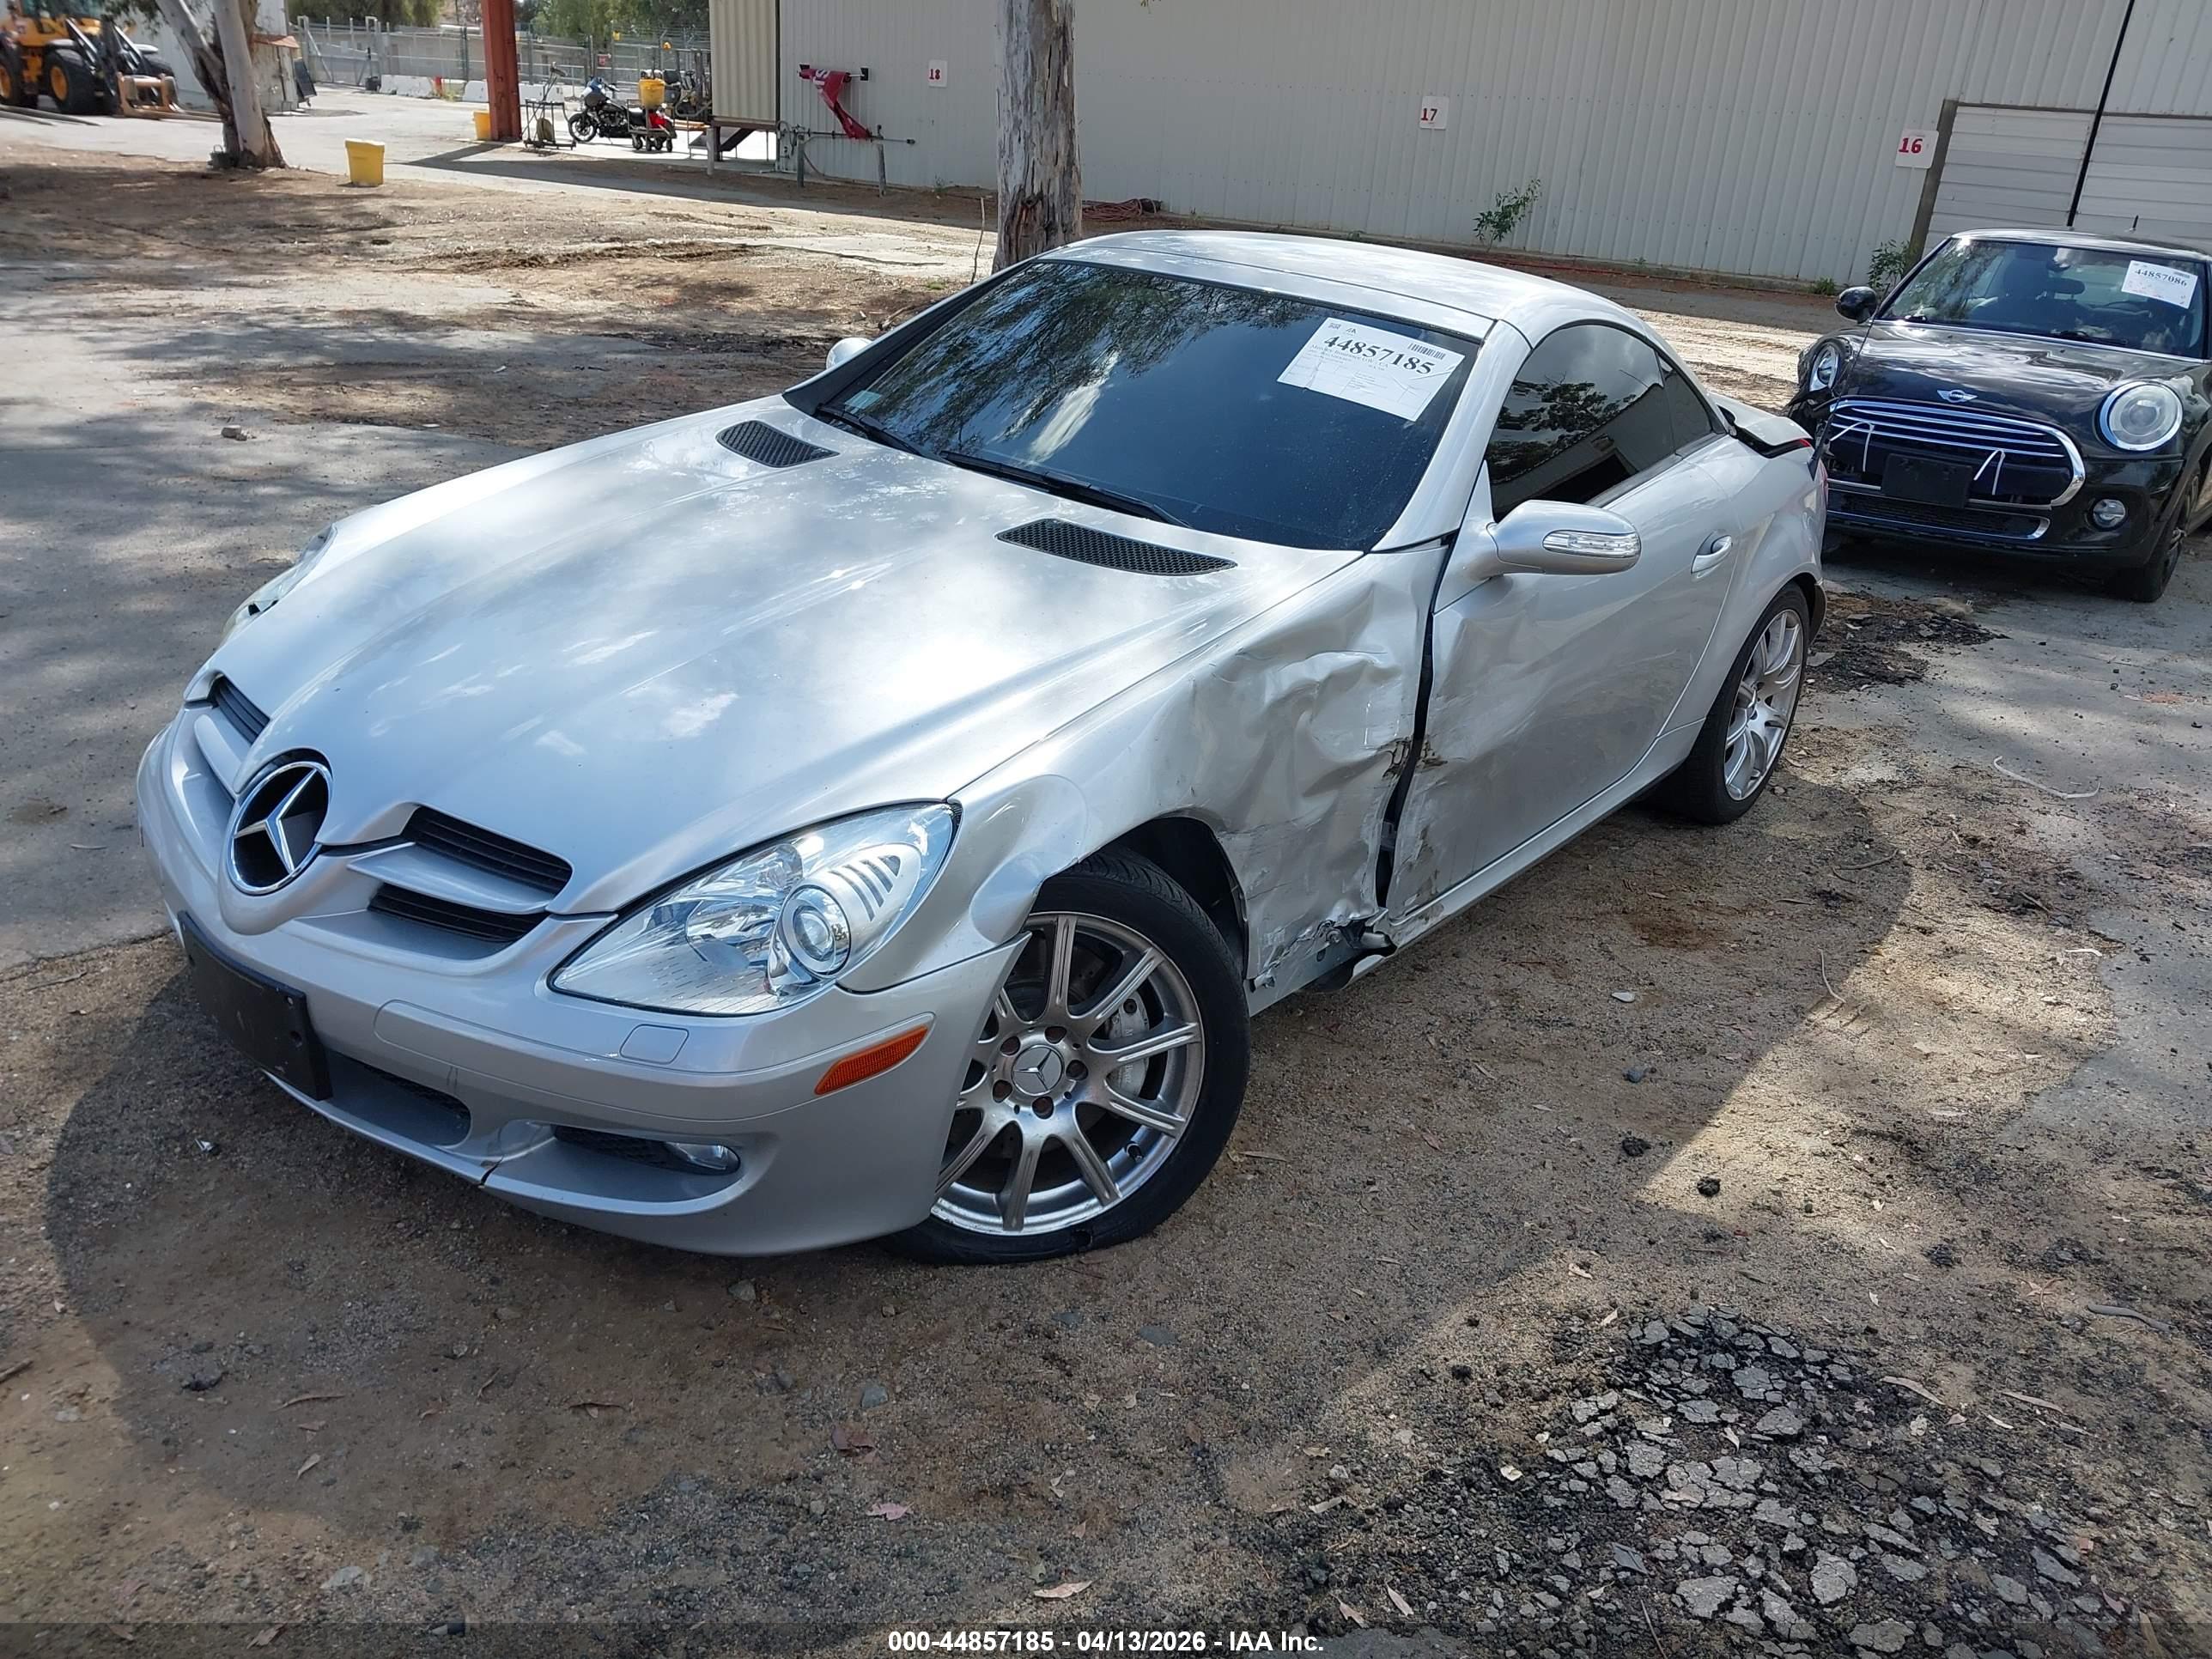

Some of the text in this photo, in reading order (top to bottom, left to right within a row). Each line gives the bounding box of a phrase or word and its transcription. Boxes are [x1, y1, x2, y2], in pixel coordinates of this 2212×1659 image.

[929, 68, 941, 81] 18
[1420, 107, 1438, 122] 17
[1898, 137, 1923, 154] 16
[2135, 268, 2188, 287] 44857086
[1323, 335, 1436, 375] 44857185
